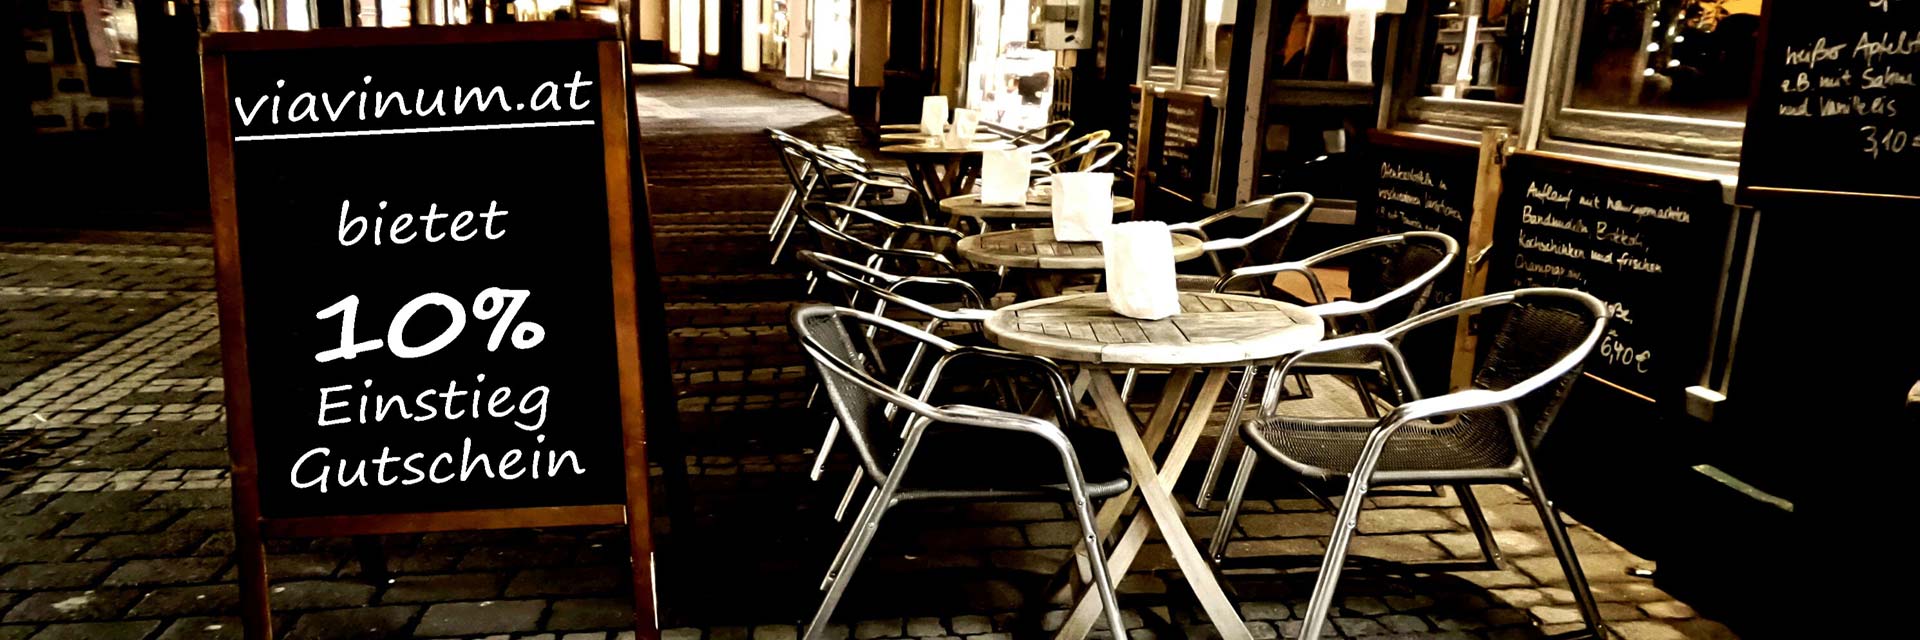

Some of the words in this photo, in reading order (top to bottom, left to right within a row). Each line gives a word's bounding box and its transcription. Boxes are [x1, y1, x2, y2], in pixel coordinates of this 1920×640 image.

[235, 71, 593, 126] viavinum.at
[1819, 68, 1852, 88] mit
[1861, 66, 1916, 89] Sahne
[1779, 97, 1812, 117] und
[1526, 181, 1573, 209] Auflauf
[1578, 193, 1600, 209] mit
[339, 200, 508, 246] bietet
[1591, 249, 1614, 265] und
[1617, 252, 1663, 273] frischen
[315, 287, 545, 362] 10%
[318, 374, 549, 431] Einstieg
[291, 434, 585, 493] Gutschein
